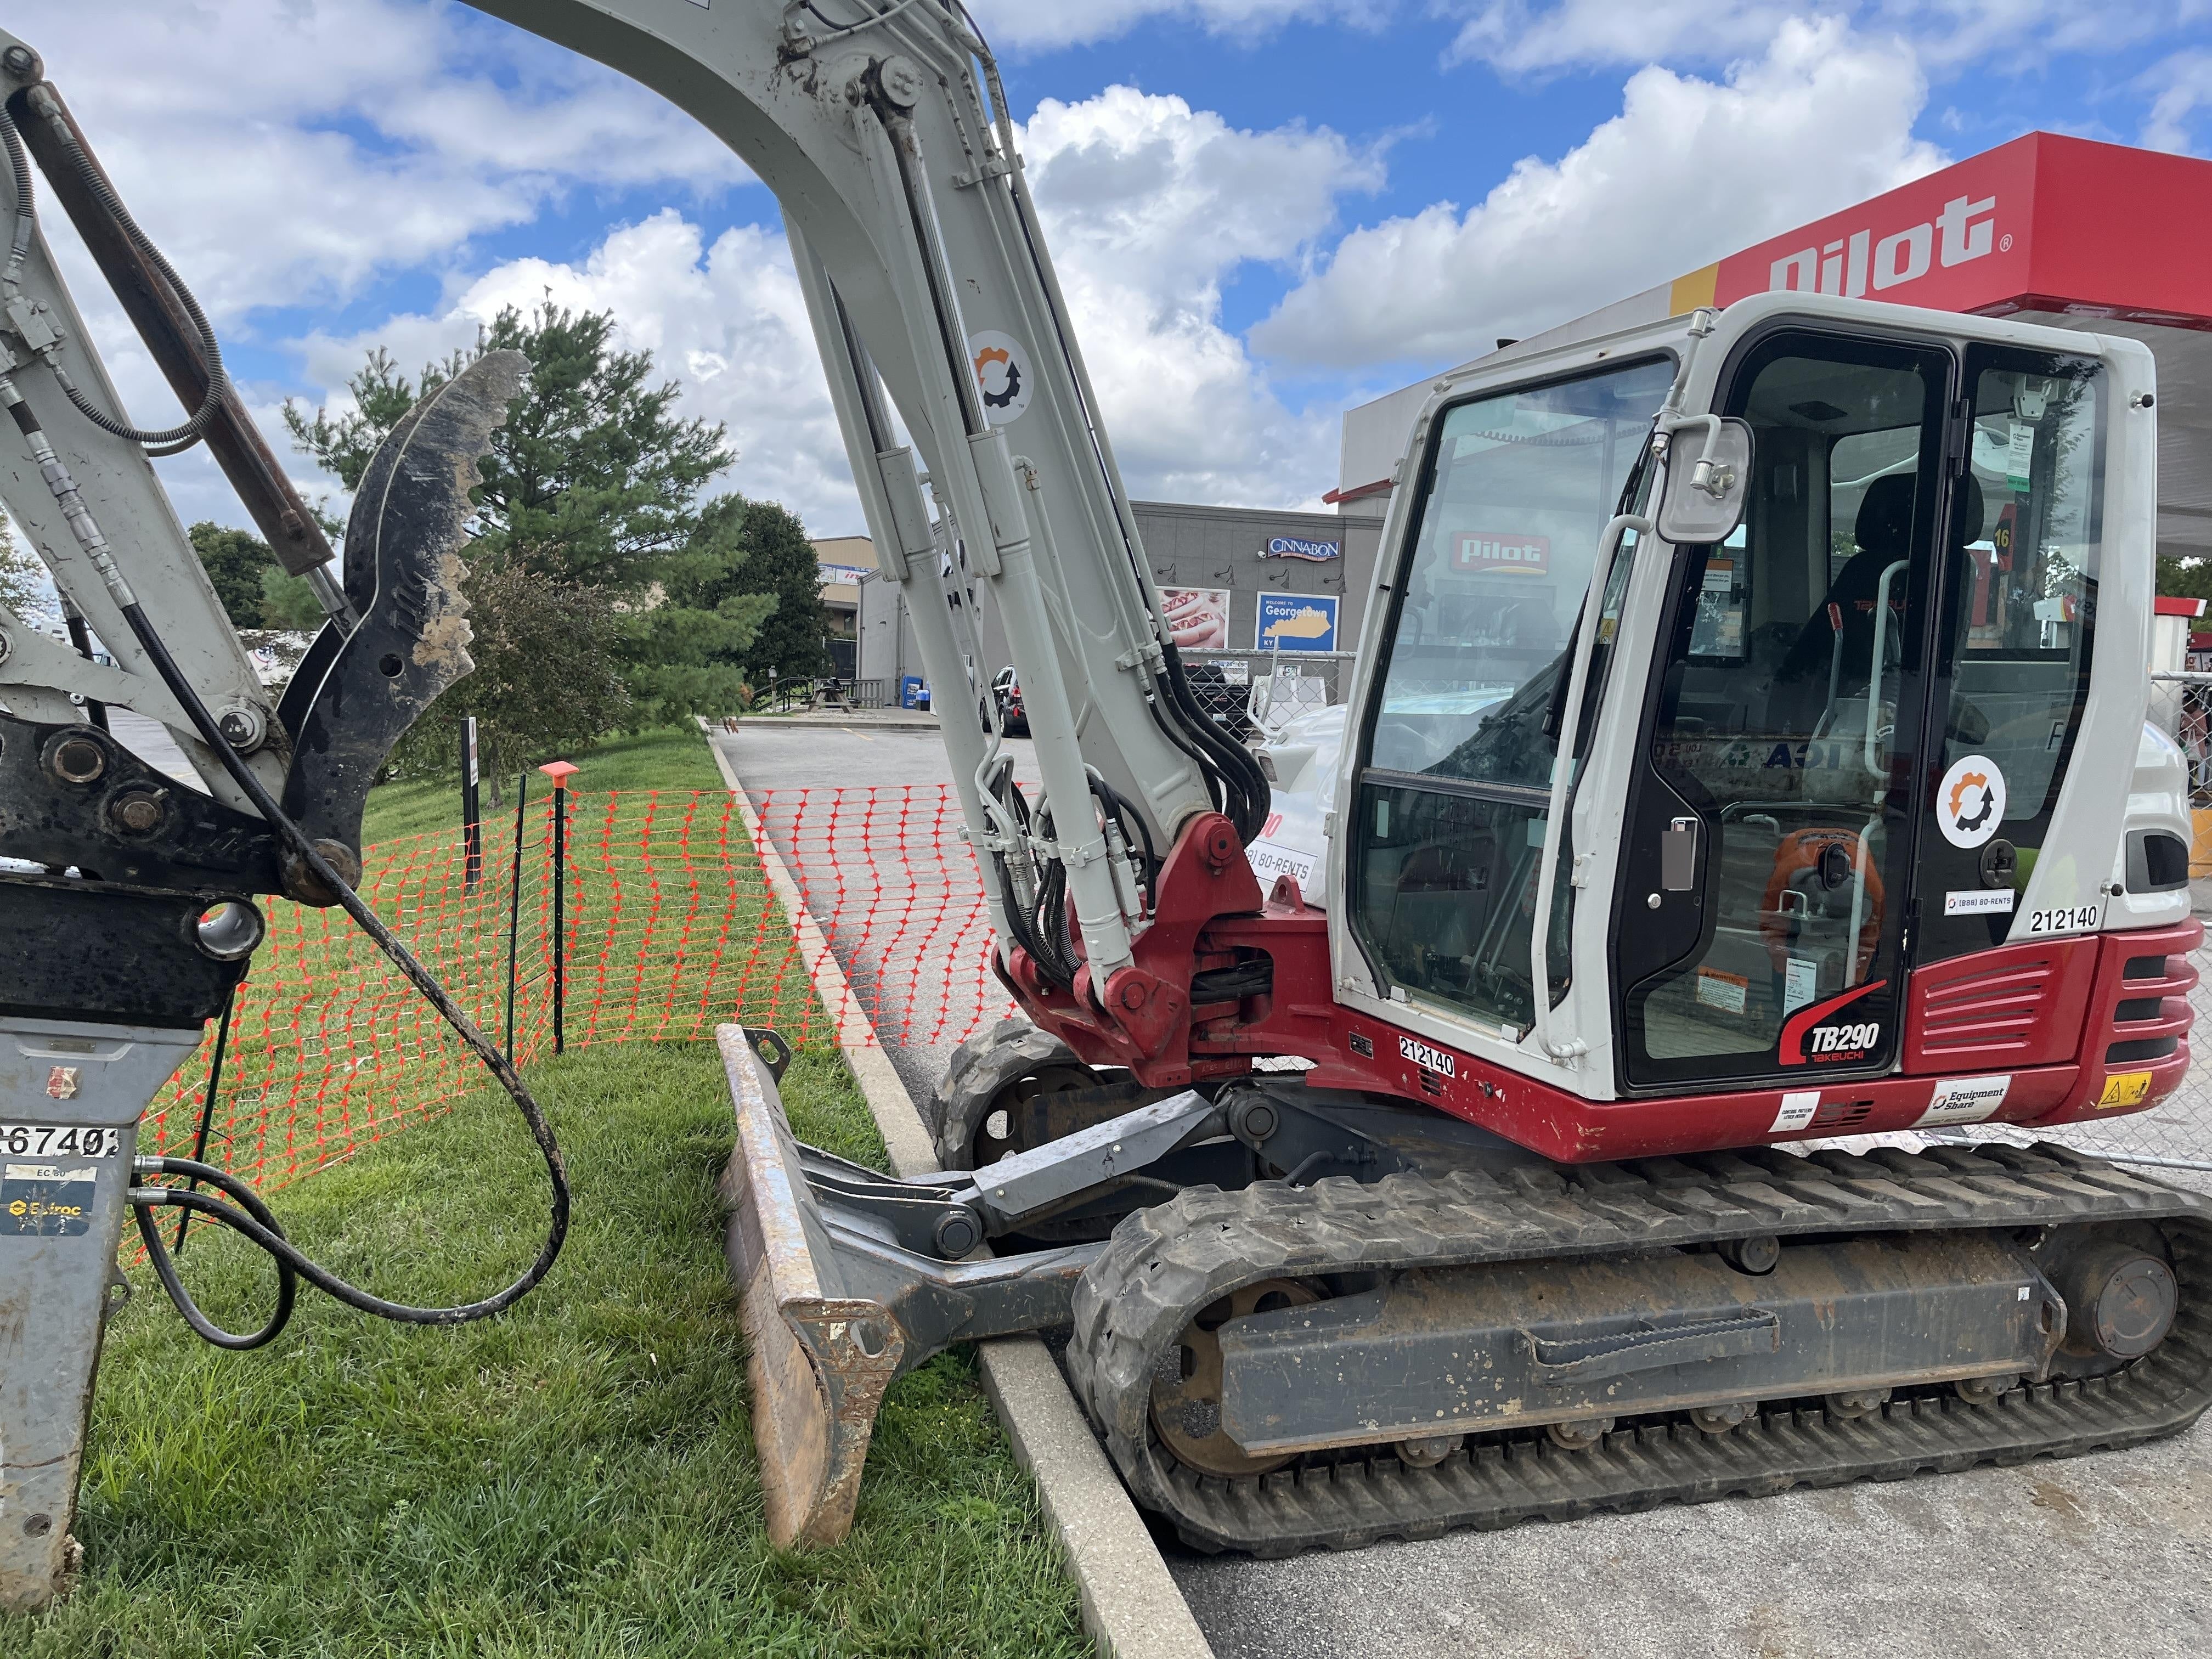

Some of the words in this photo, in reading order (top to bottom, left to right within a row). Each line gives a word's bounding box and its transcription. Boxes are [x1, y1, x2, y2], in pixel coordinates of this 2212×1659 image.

[1769, 195, 1996, 298] Pilot
[1270, 538, 1339, 556] CINNABON
[1995, 528, 2009, 548] 16
[1462, 539, 1541, 563] Pilot
[1266, 605, 1328, 618] Georgetown
[1258, 853, 1309, 879] 80-RENTS
[1959, 898, 1978, 906] (888)
[1979, 897, 2011, 906] 80-RENTS
[2031, 906, 2097, 932] 212140
[1812, 1023, 1880, 1053] TB290
[1400, 1037, 1453, 1075] 212140
[1811, 1050, 1864, 1063] TAKEUCHI
[1949, 1088, 2004, 1102] Equipment
[1944, 1101, 1974, 1110] Share
